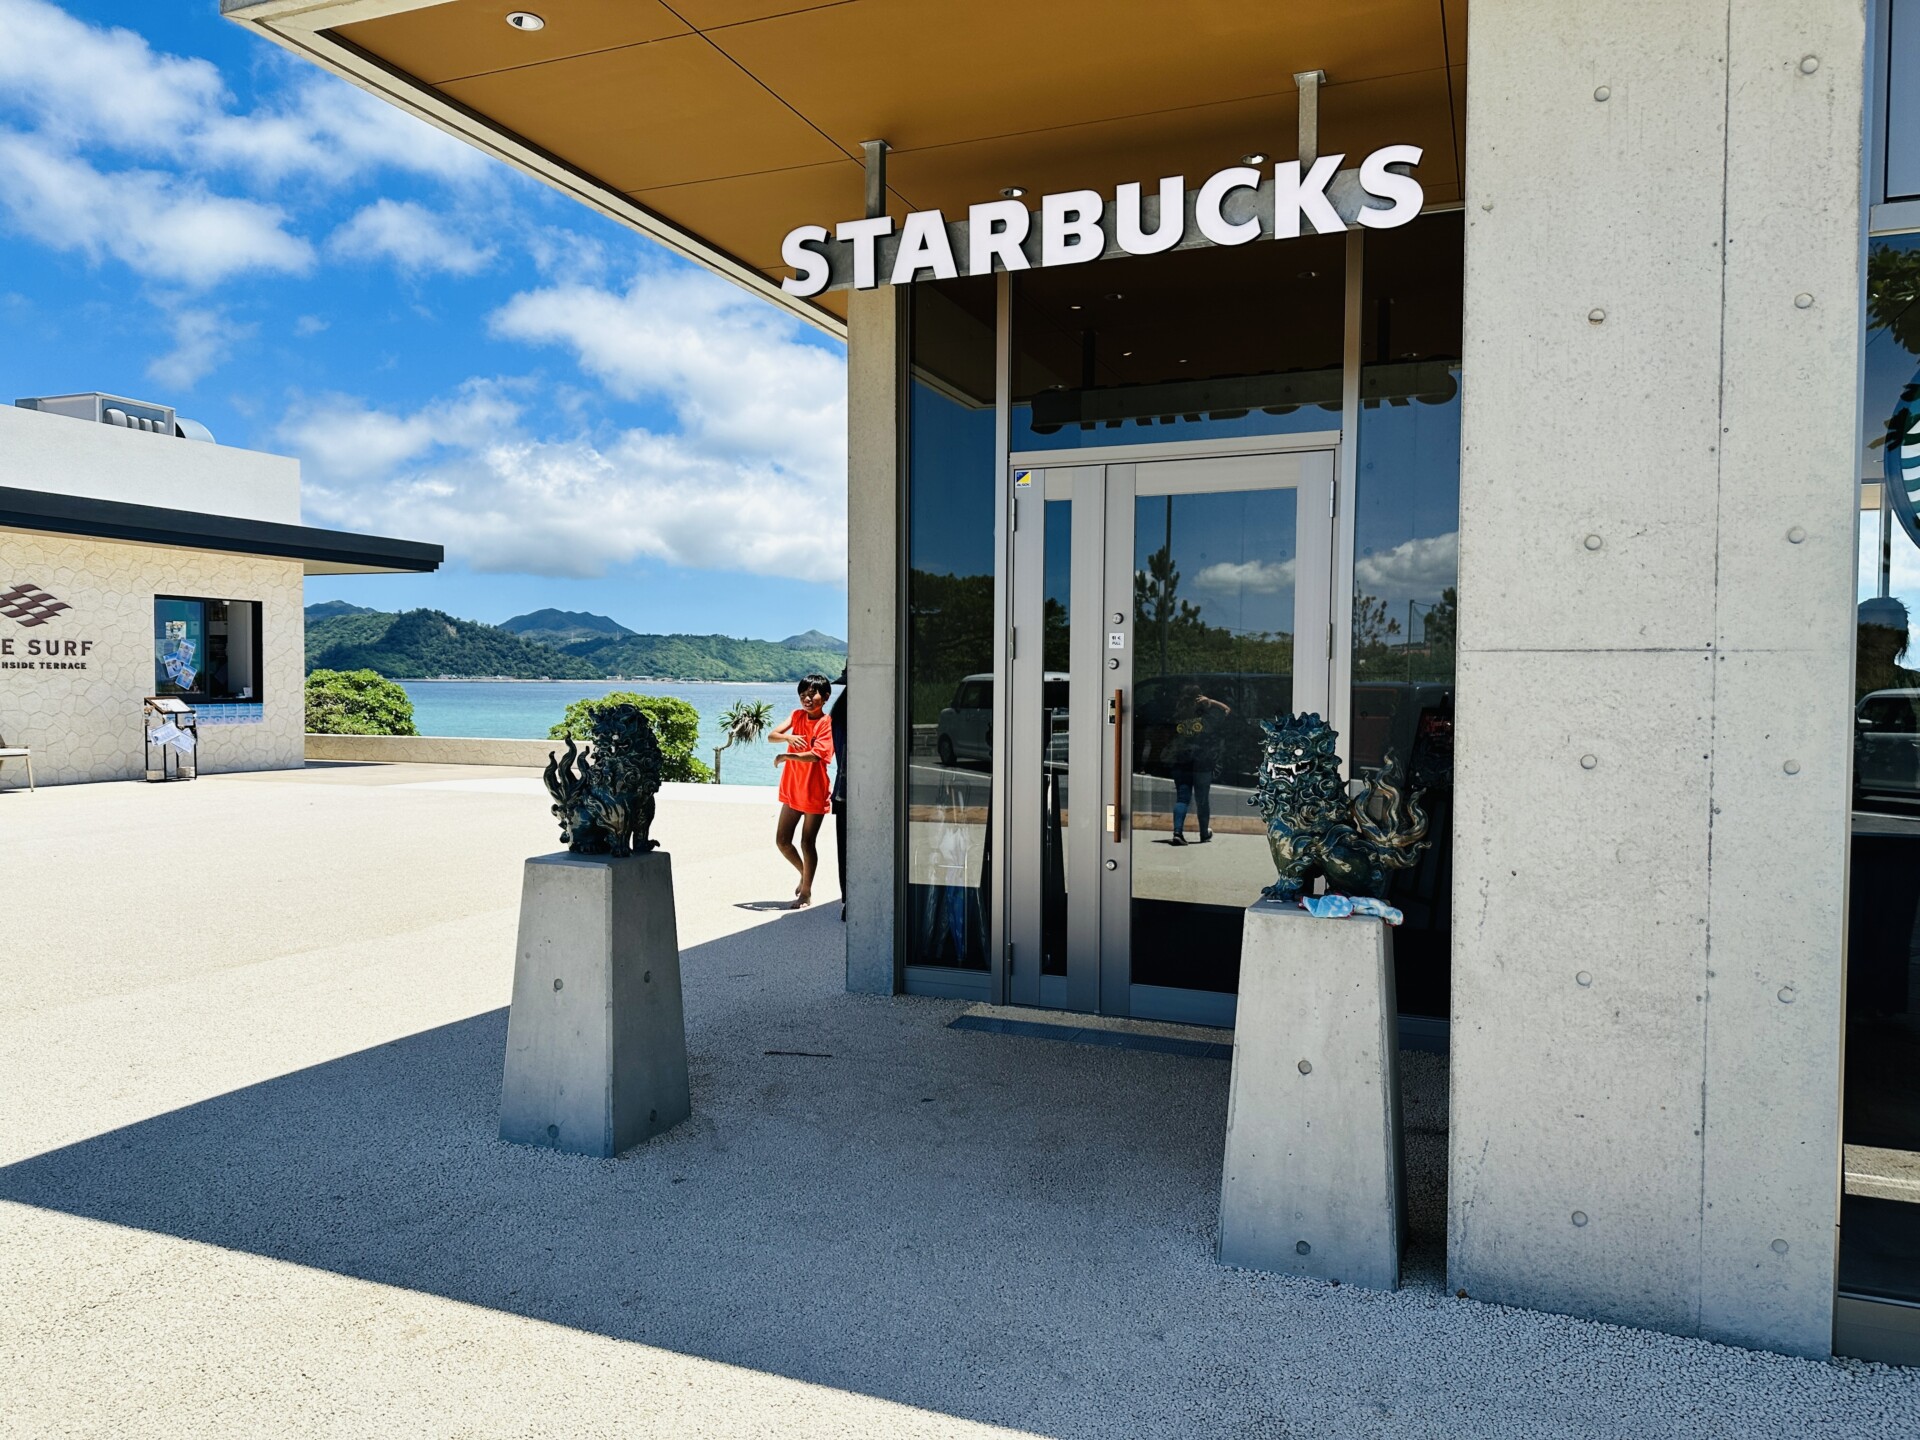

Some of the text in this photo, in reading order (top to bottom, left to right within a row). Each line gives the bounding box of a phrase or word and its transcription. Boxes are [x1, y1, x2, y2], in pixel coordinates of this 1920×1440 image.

[780, 144, 1425, 299] STARBUCKS
[27, 639, 93, 656] SURF
[38, 662, 87, 670] TERRACE
